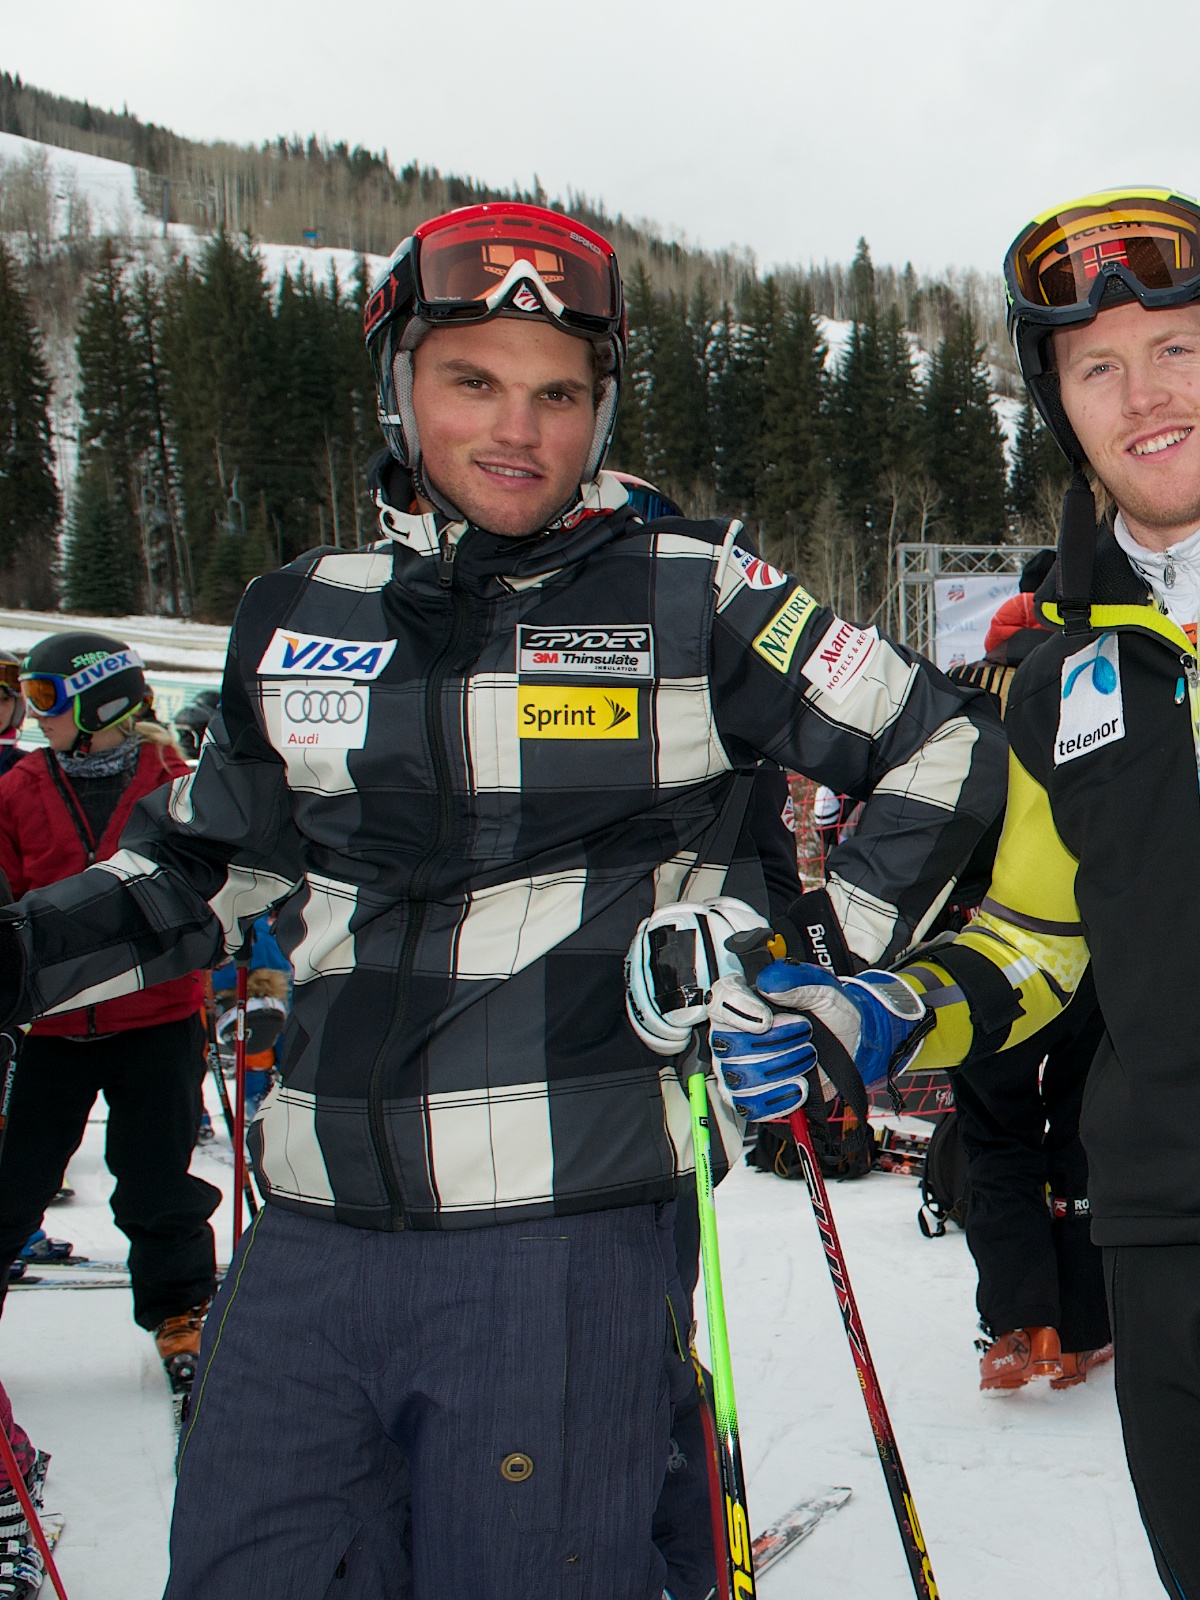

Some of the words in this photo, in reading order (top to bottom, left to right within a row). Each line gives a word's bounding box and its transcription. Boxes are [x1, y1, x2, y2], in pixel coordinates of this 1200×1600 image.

[569, 231, 602, 255] BRIKO
[526, 631, 647, 649] SPYDER
[759, 592, 811, 667] NATURE
[281, 636, 383, 674] VISA
[533, 653, 559, 664] 3M
[562, 653, 639, 666] Thinsulate
[827, 655, 854, 690] HOTELS
[852, 647, 859, 655] &
[70, 653, 132, 690] uvex
[523, 704, 596, 731] Sprint
[288, 733, 319, 744] Audi
[1059, 718, 1119, 756] telenor
